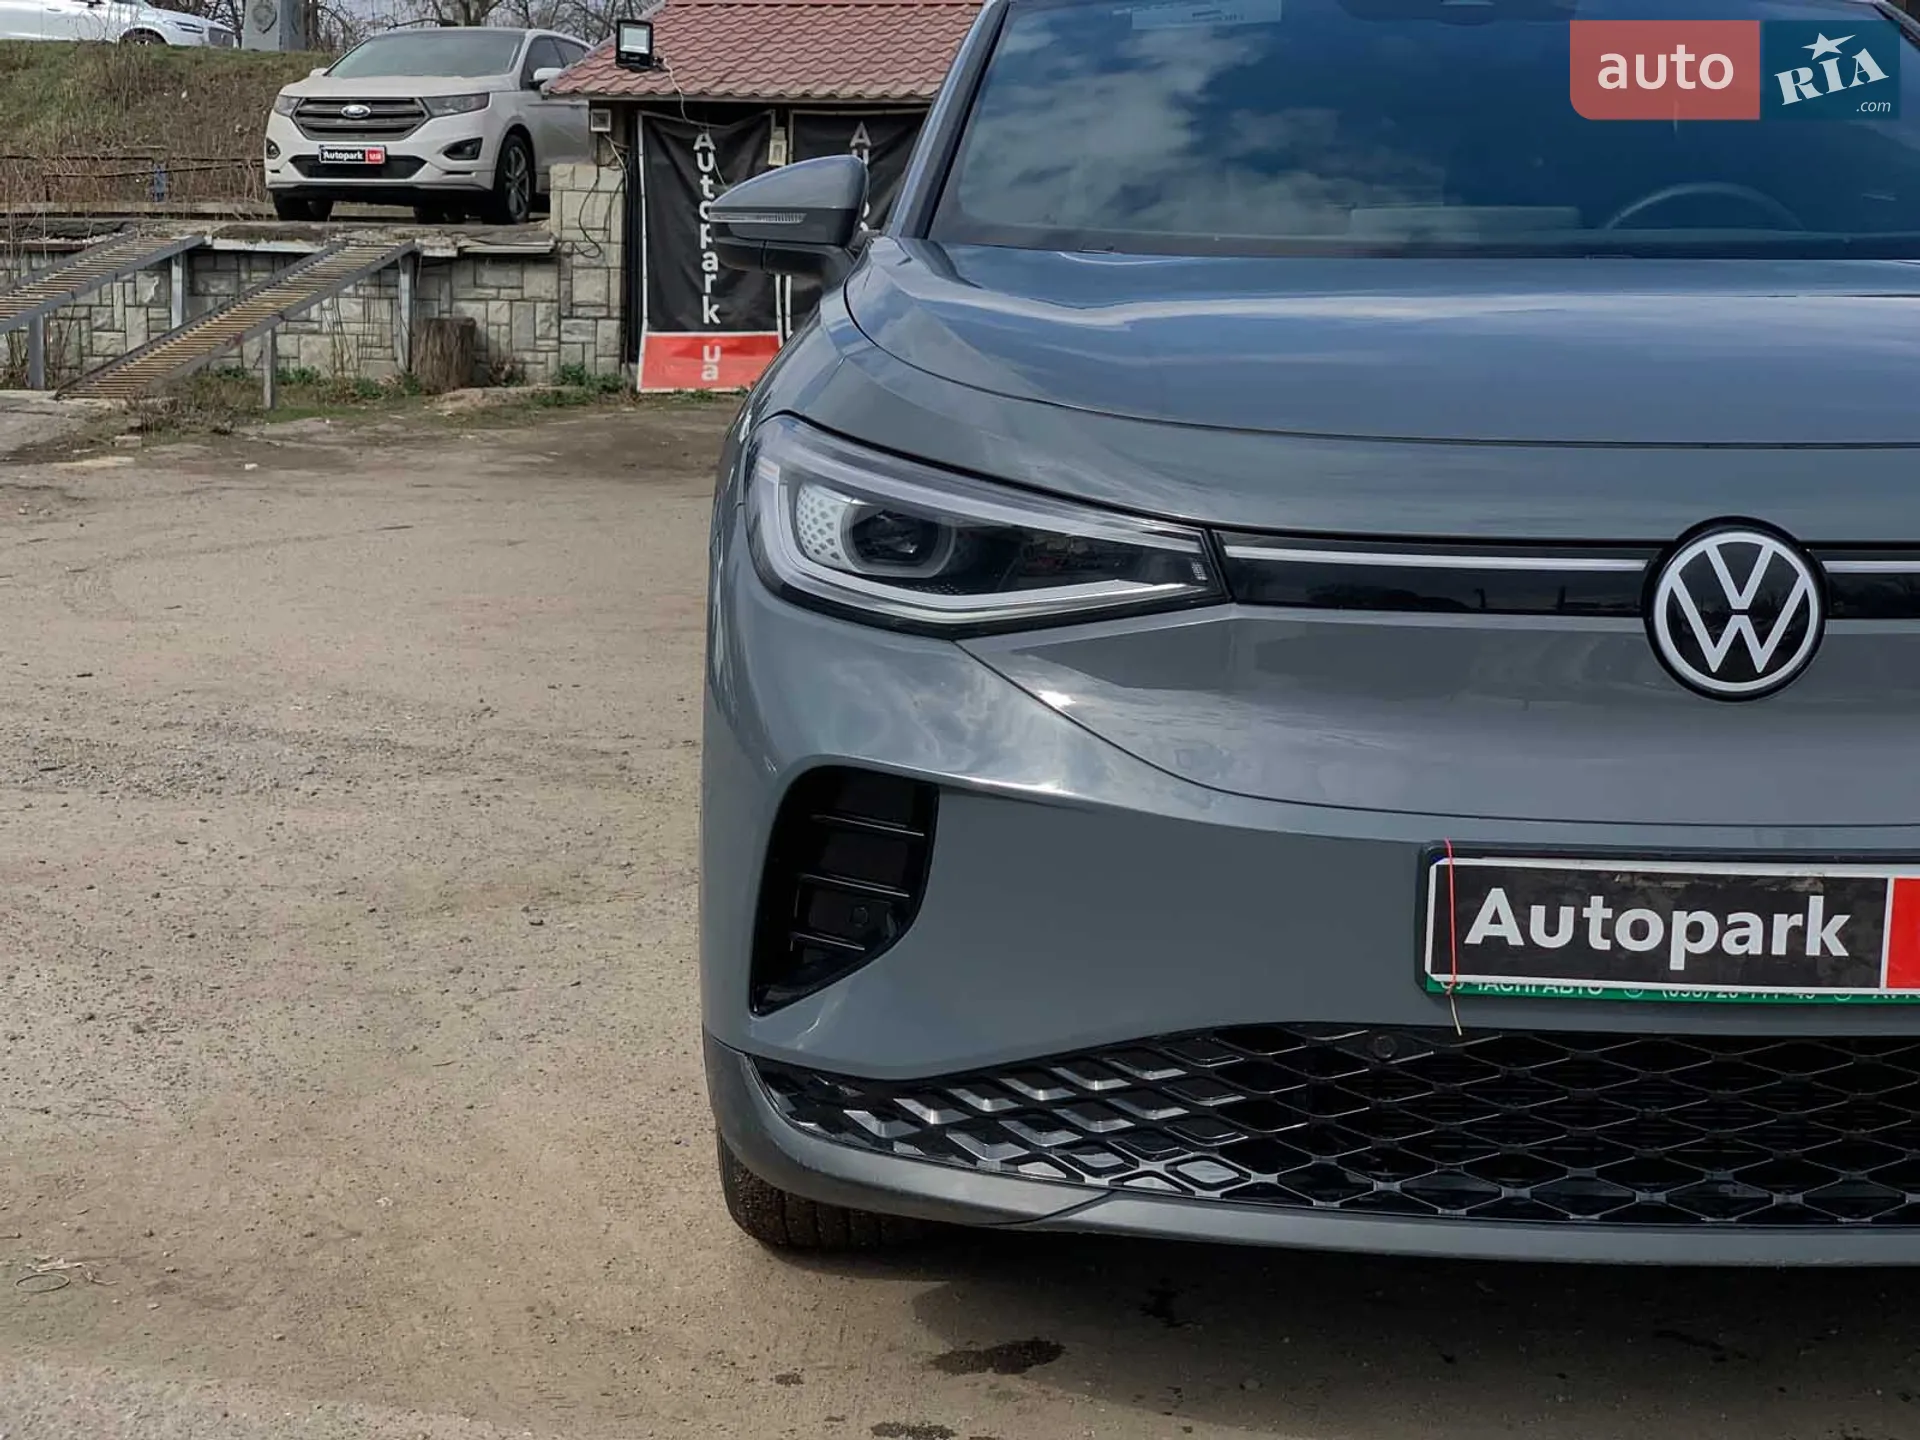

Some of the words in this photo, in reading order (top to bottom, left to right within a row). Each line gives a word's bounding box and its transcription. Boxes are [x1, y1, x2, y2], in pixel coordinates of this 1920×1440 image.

[323, 151, 364, 161] Autopark
[701, 345, 721, 381] ua
[1464, 887, 1851, 970] Autopark
